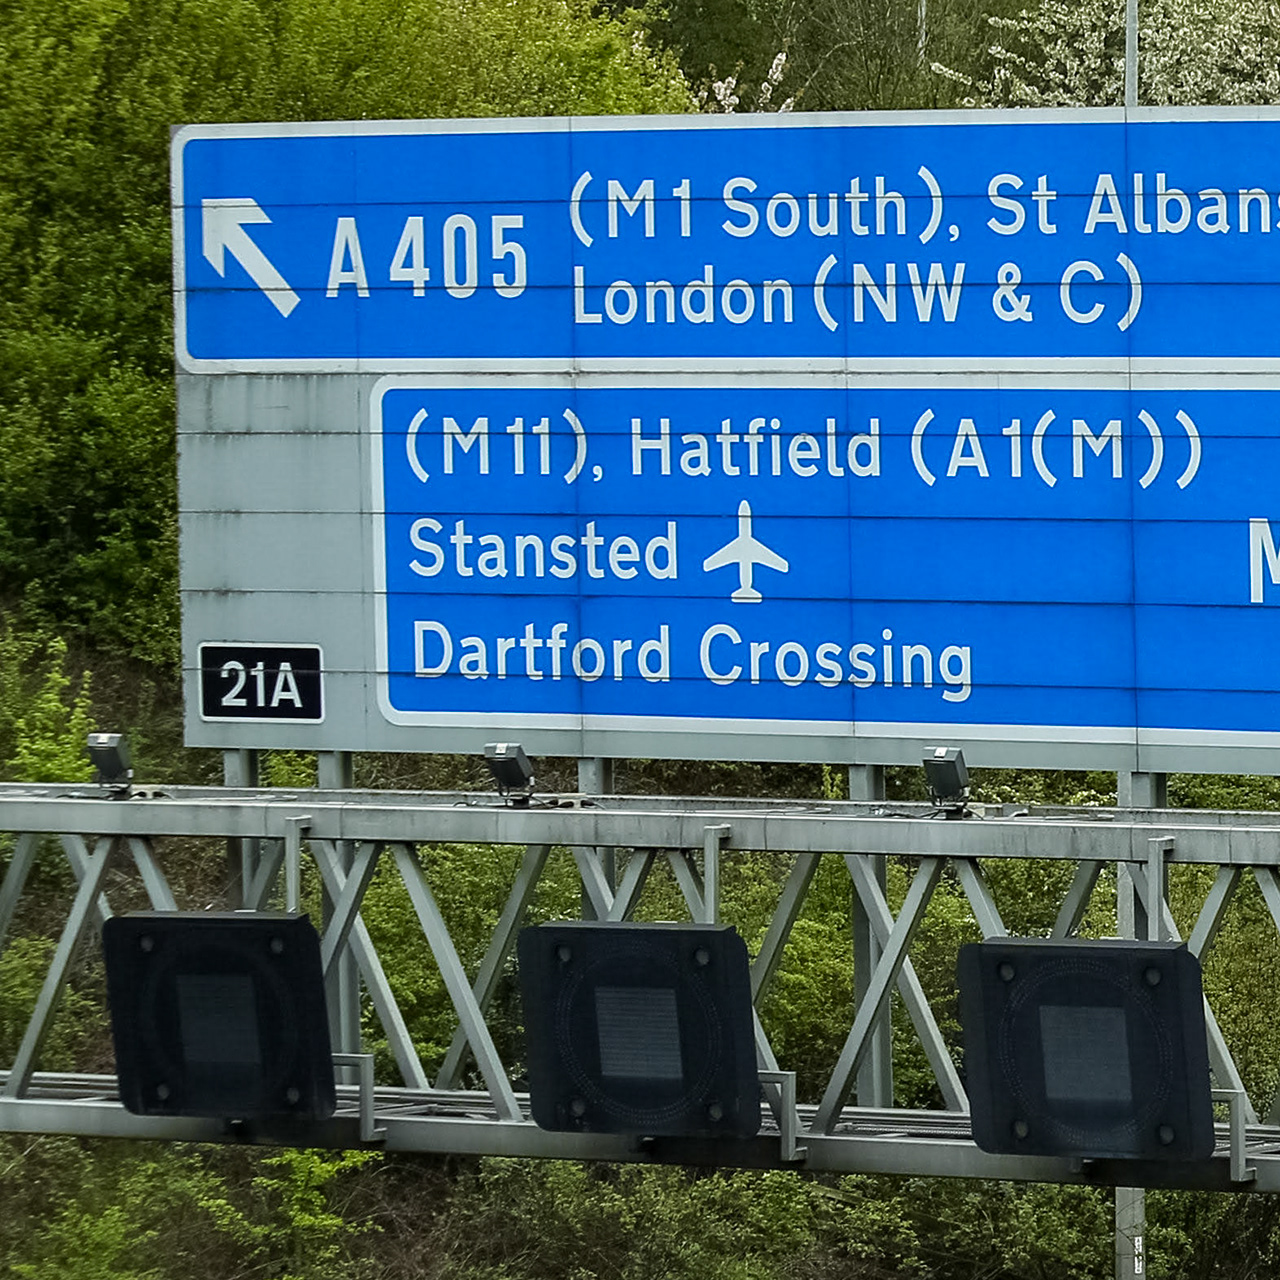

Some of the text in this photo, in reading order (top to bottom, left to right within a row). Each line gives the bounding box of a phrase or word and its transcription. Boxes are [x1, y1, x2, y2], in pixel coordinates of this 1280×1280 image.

[570, 171, 691, 247] (M1
[721, 166, 961, 244] South),
[987, 173, 1057, 234] St
[573, 252, 1142, 331] London (NW & C)
[406, 408, 1201, 489] (M11), Hatfield (A1(M))
[409, 517, 678, 580] Stansted
[220, 660, 303, 709] 21A
[414, 620, 972, 702] Dartford Crossing
